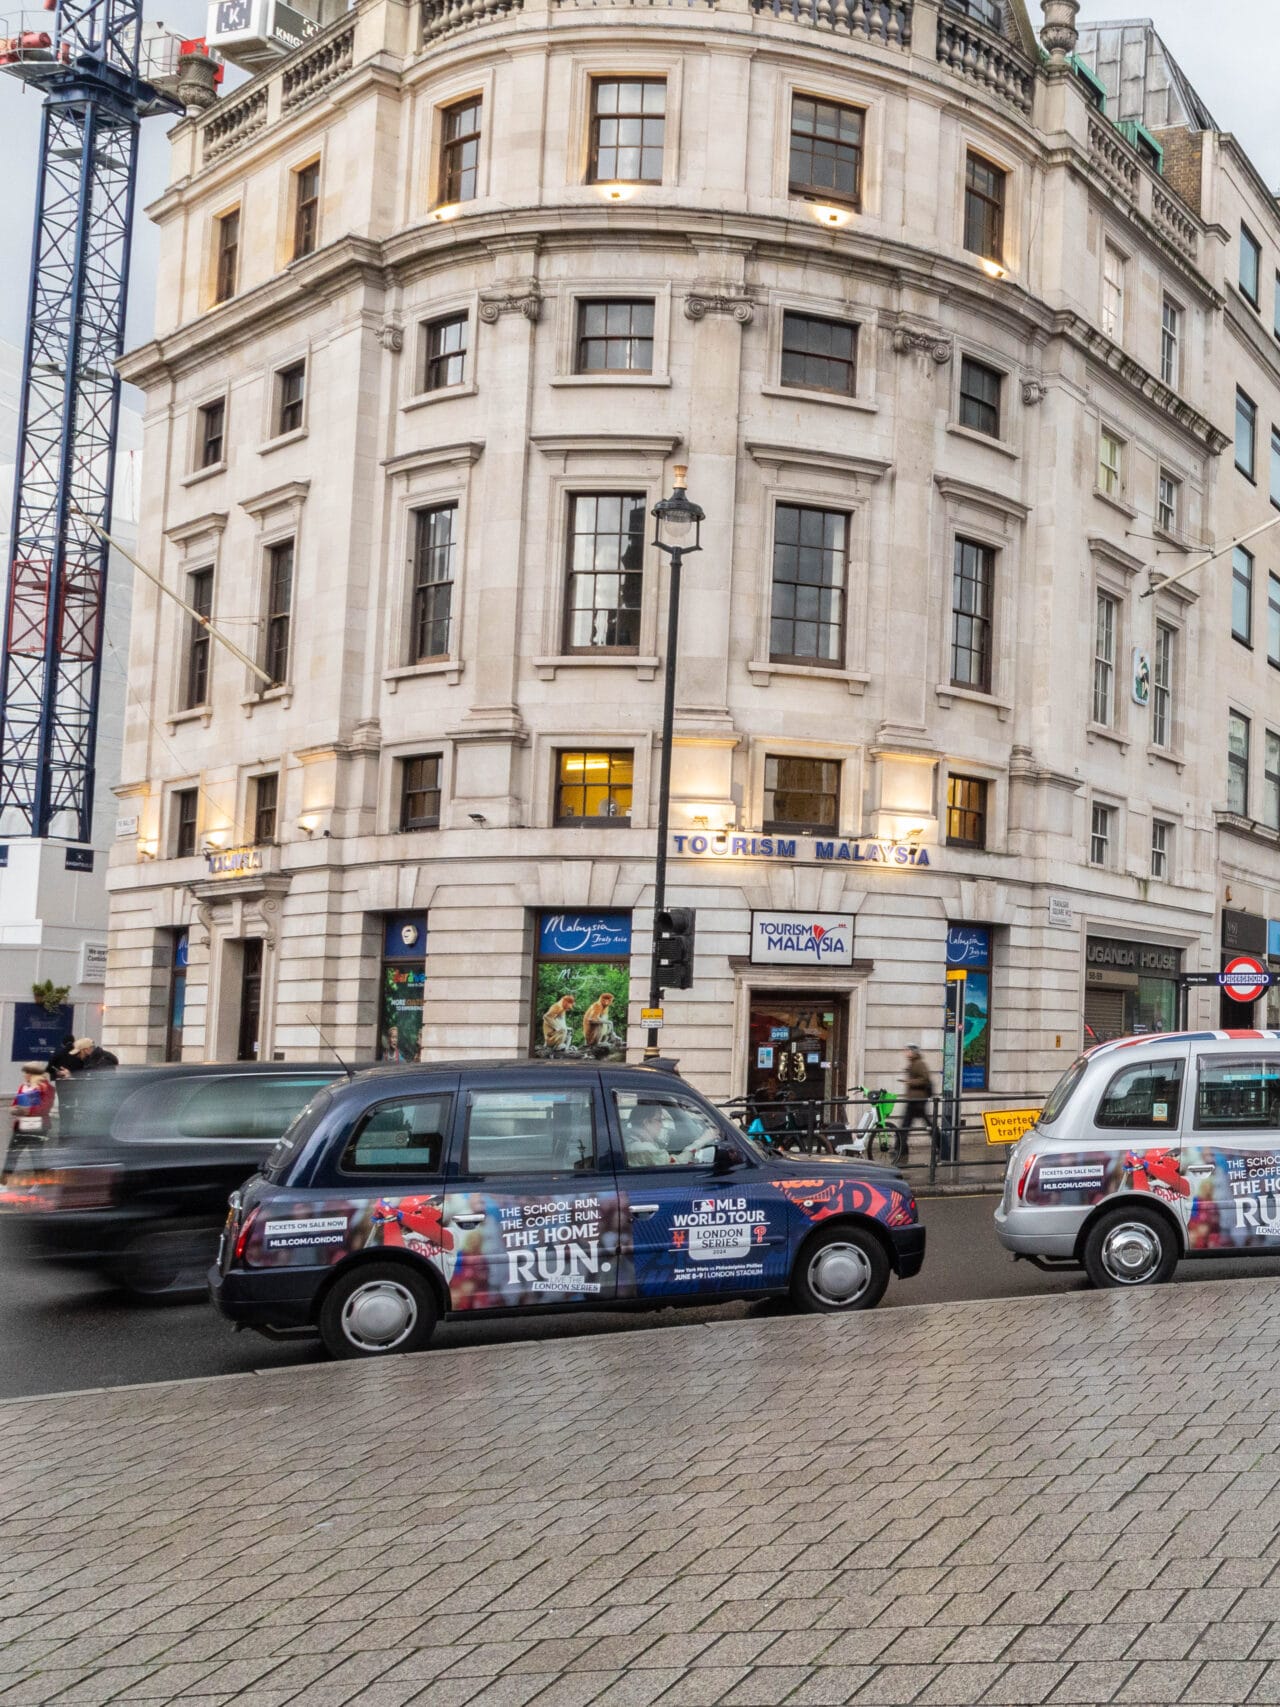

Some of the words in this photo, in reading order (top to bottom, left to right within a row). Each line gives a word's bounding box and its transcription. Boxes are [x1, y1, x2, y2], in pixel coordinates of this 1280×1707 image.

[673, 835, 796, 857] TOURISM
[815, 841, 930, 865] MALAYSIA
[544, 915, 622, 951] Malaysia
[759, 921, 813, 936] TOURISM
[767, 934, 845, 960] MALAYSIA
[1087, 944, 1136, 967] UGANDA
[1140, 951, 1176, 970] HOUSE
[1218, 974, 1270, 984] UNDERGROUND
[771, 1031, 789, 1039] OPEN
[990, 1115, 1034, 1126] Diverted
[1227, 1159, 1245, 1169] THE
[1227, 1170, 1247, 1181] THE
[1043, 1181, 1101, 1190] MLB.COM/LONDON
[1230, 1179, 1261, 1196] THE
[499, 1207, 521, 1218] THE
[523, 1201, 572, 1215] SCHOOL
[575, 1198, 600, 1209] RUN.
[716, 1198, 747, 1211] MLB
[500, 1219, 523, 1231] THE
[525, 1214, 571, 1228] COFFEE
[574, 1210, 602, 1221] RUN.
[673, 1211, 726, 1227] WORLD
[727, 1210, 765, 1223] TOUR
[268, 1223, 296, 1231] TICKETS
[309, 1221, 326, 1229] SALE
[502, 1230, 540, 1248] THE
[544, 1222, 600, 1243] HOME
[697, 1228, 743, 1240] LONDON
[269, 1235, 344, 1248] MLB.COM/LONDON
[701, 1237, 739, 1249] SERIES
[506, 1240, 611, 1285] RUN.
[674, 1273, 691, 1281] JUNE
[707, 1270, 735, 1278] LONDON
[736, 1268, 763, 1277] STADIUM
[534, 1281, 569, 1291] LONDON
